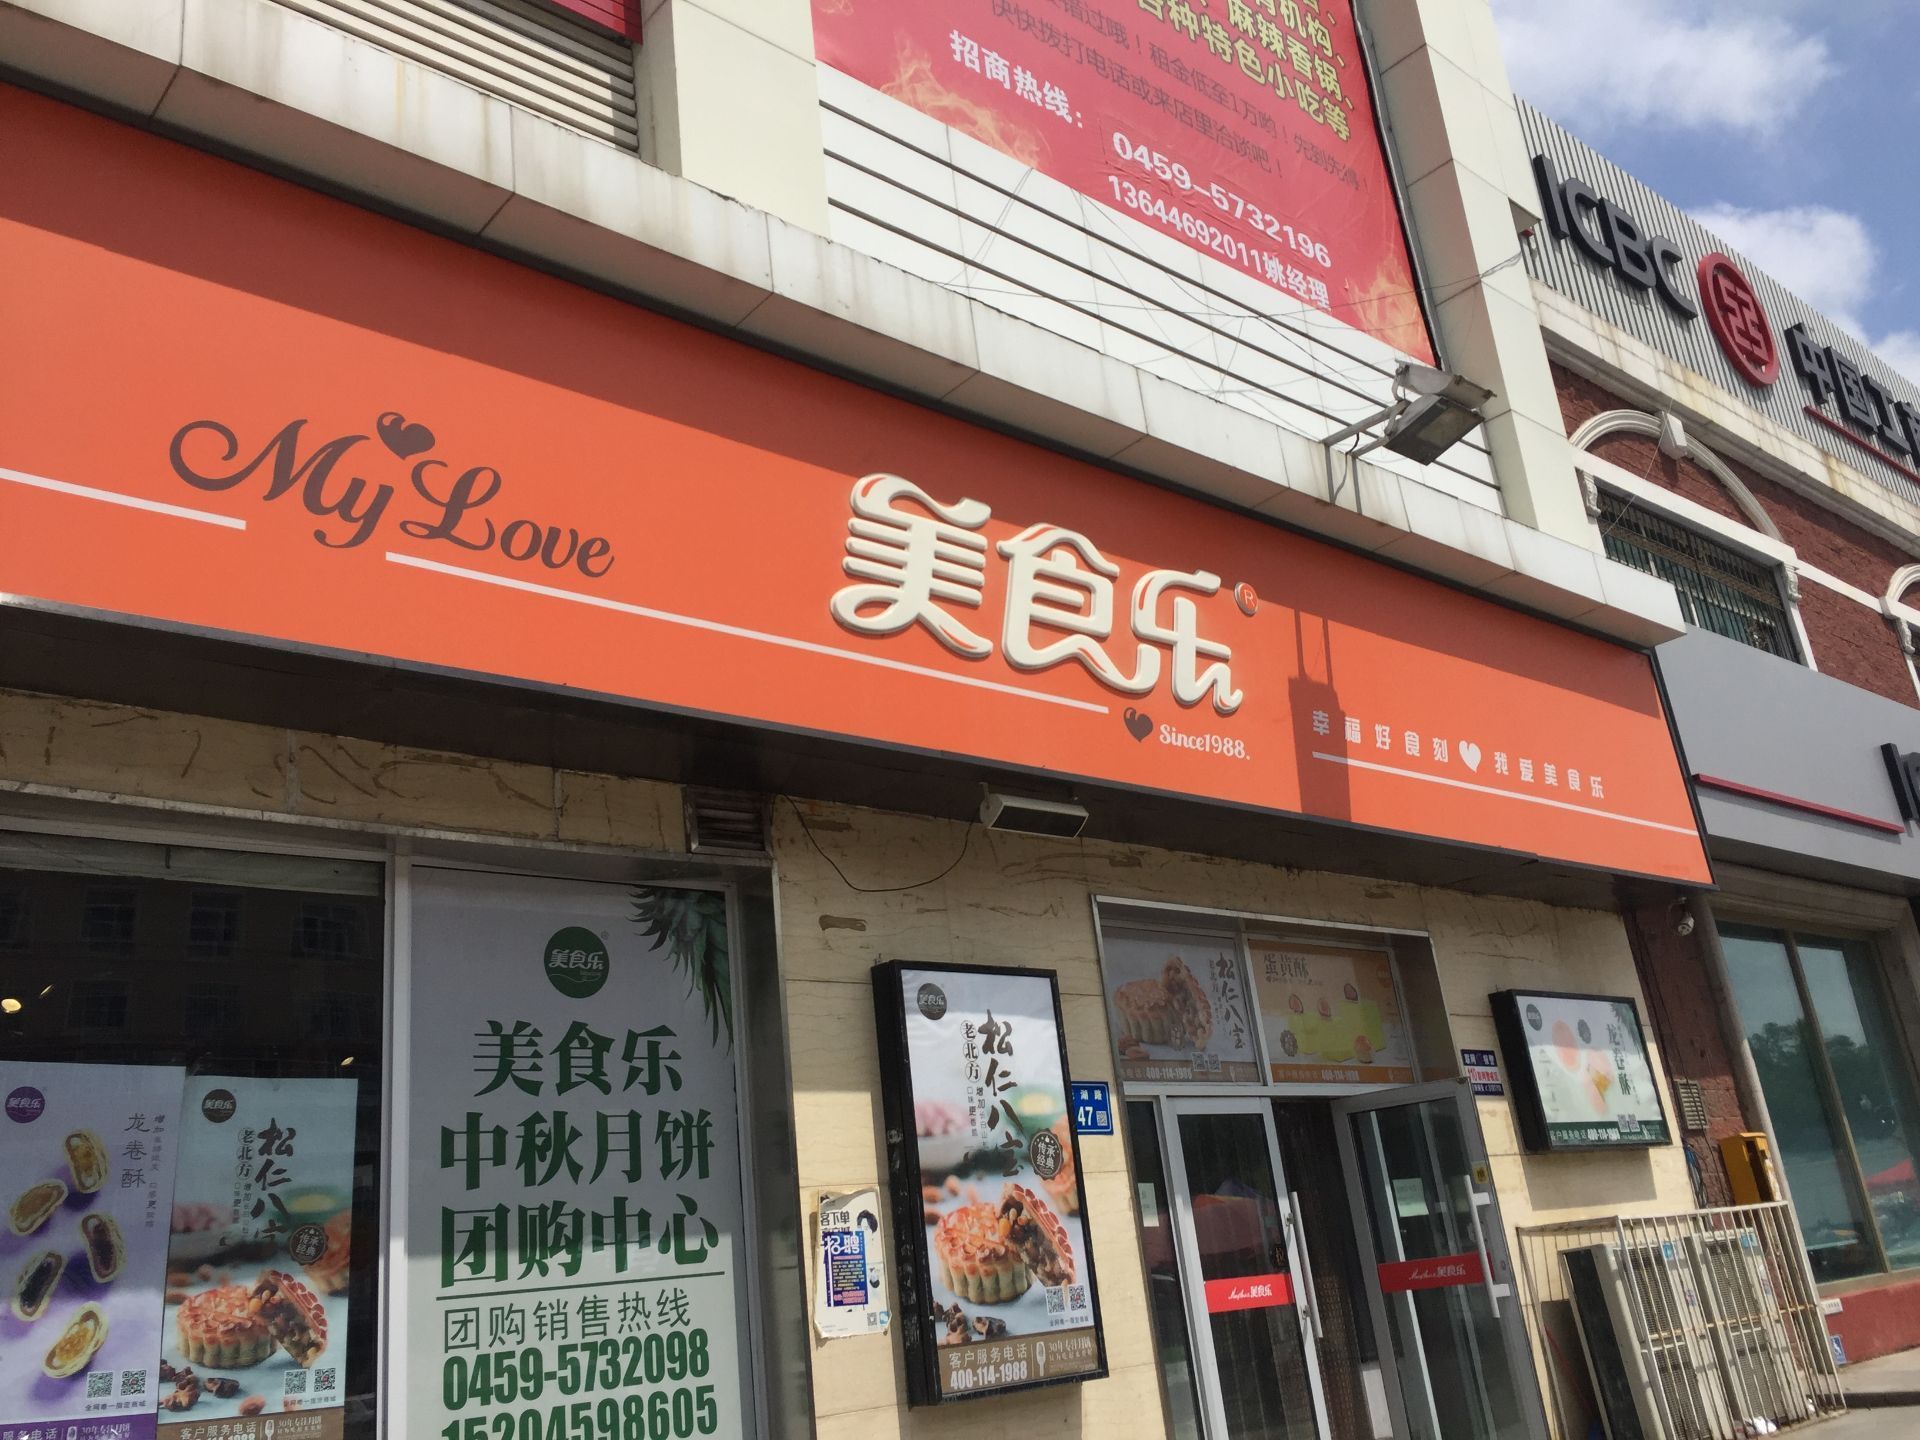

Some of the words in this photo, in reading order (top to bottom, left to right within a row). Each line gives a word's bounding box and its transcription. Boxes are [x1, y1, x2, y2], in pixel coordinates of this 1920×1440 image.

[1533, 154, 1699, 321] ICBC
[169, 419, 395, 549] My
[399, 459, 616, 578] Love
[830, 473, 1243, 714] 美食乐
[1312, 710, 1450, 763] 幸福好食刻
[1493, 751, 1605, 800] 我爱美食乐
[548, 948, 604, 970] 美食乐
[473, 1019, 682, 1097] 美食乐
[121, 1113, 151, 1189] 龙卷酥
[440, 1108, 715, 1191] 中秋月饼
[1078, 1106, 1093, 1126] 47
[441, 1193, 719, 1288] 团购中心
[823, 1235, 860, 1255] 招聘
[444, 1287, 691, 1354] 团购销售热线
[949, 1343, 1028, 1369] 客户服务电话
[442, 1328, 710, 1411] 0459-5732098
[950, 1360, 1028, 1390] 400-114-1988
